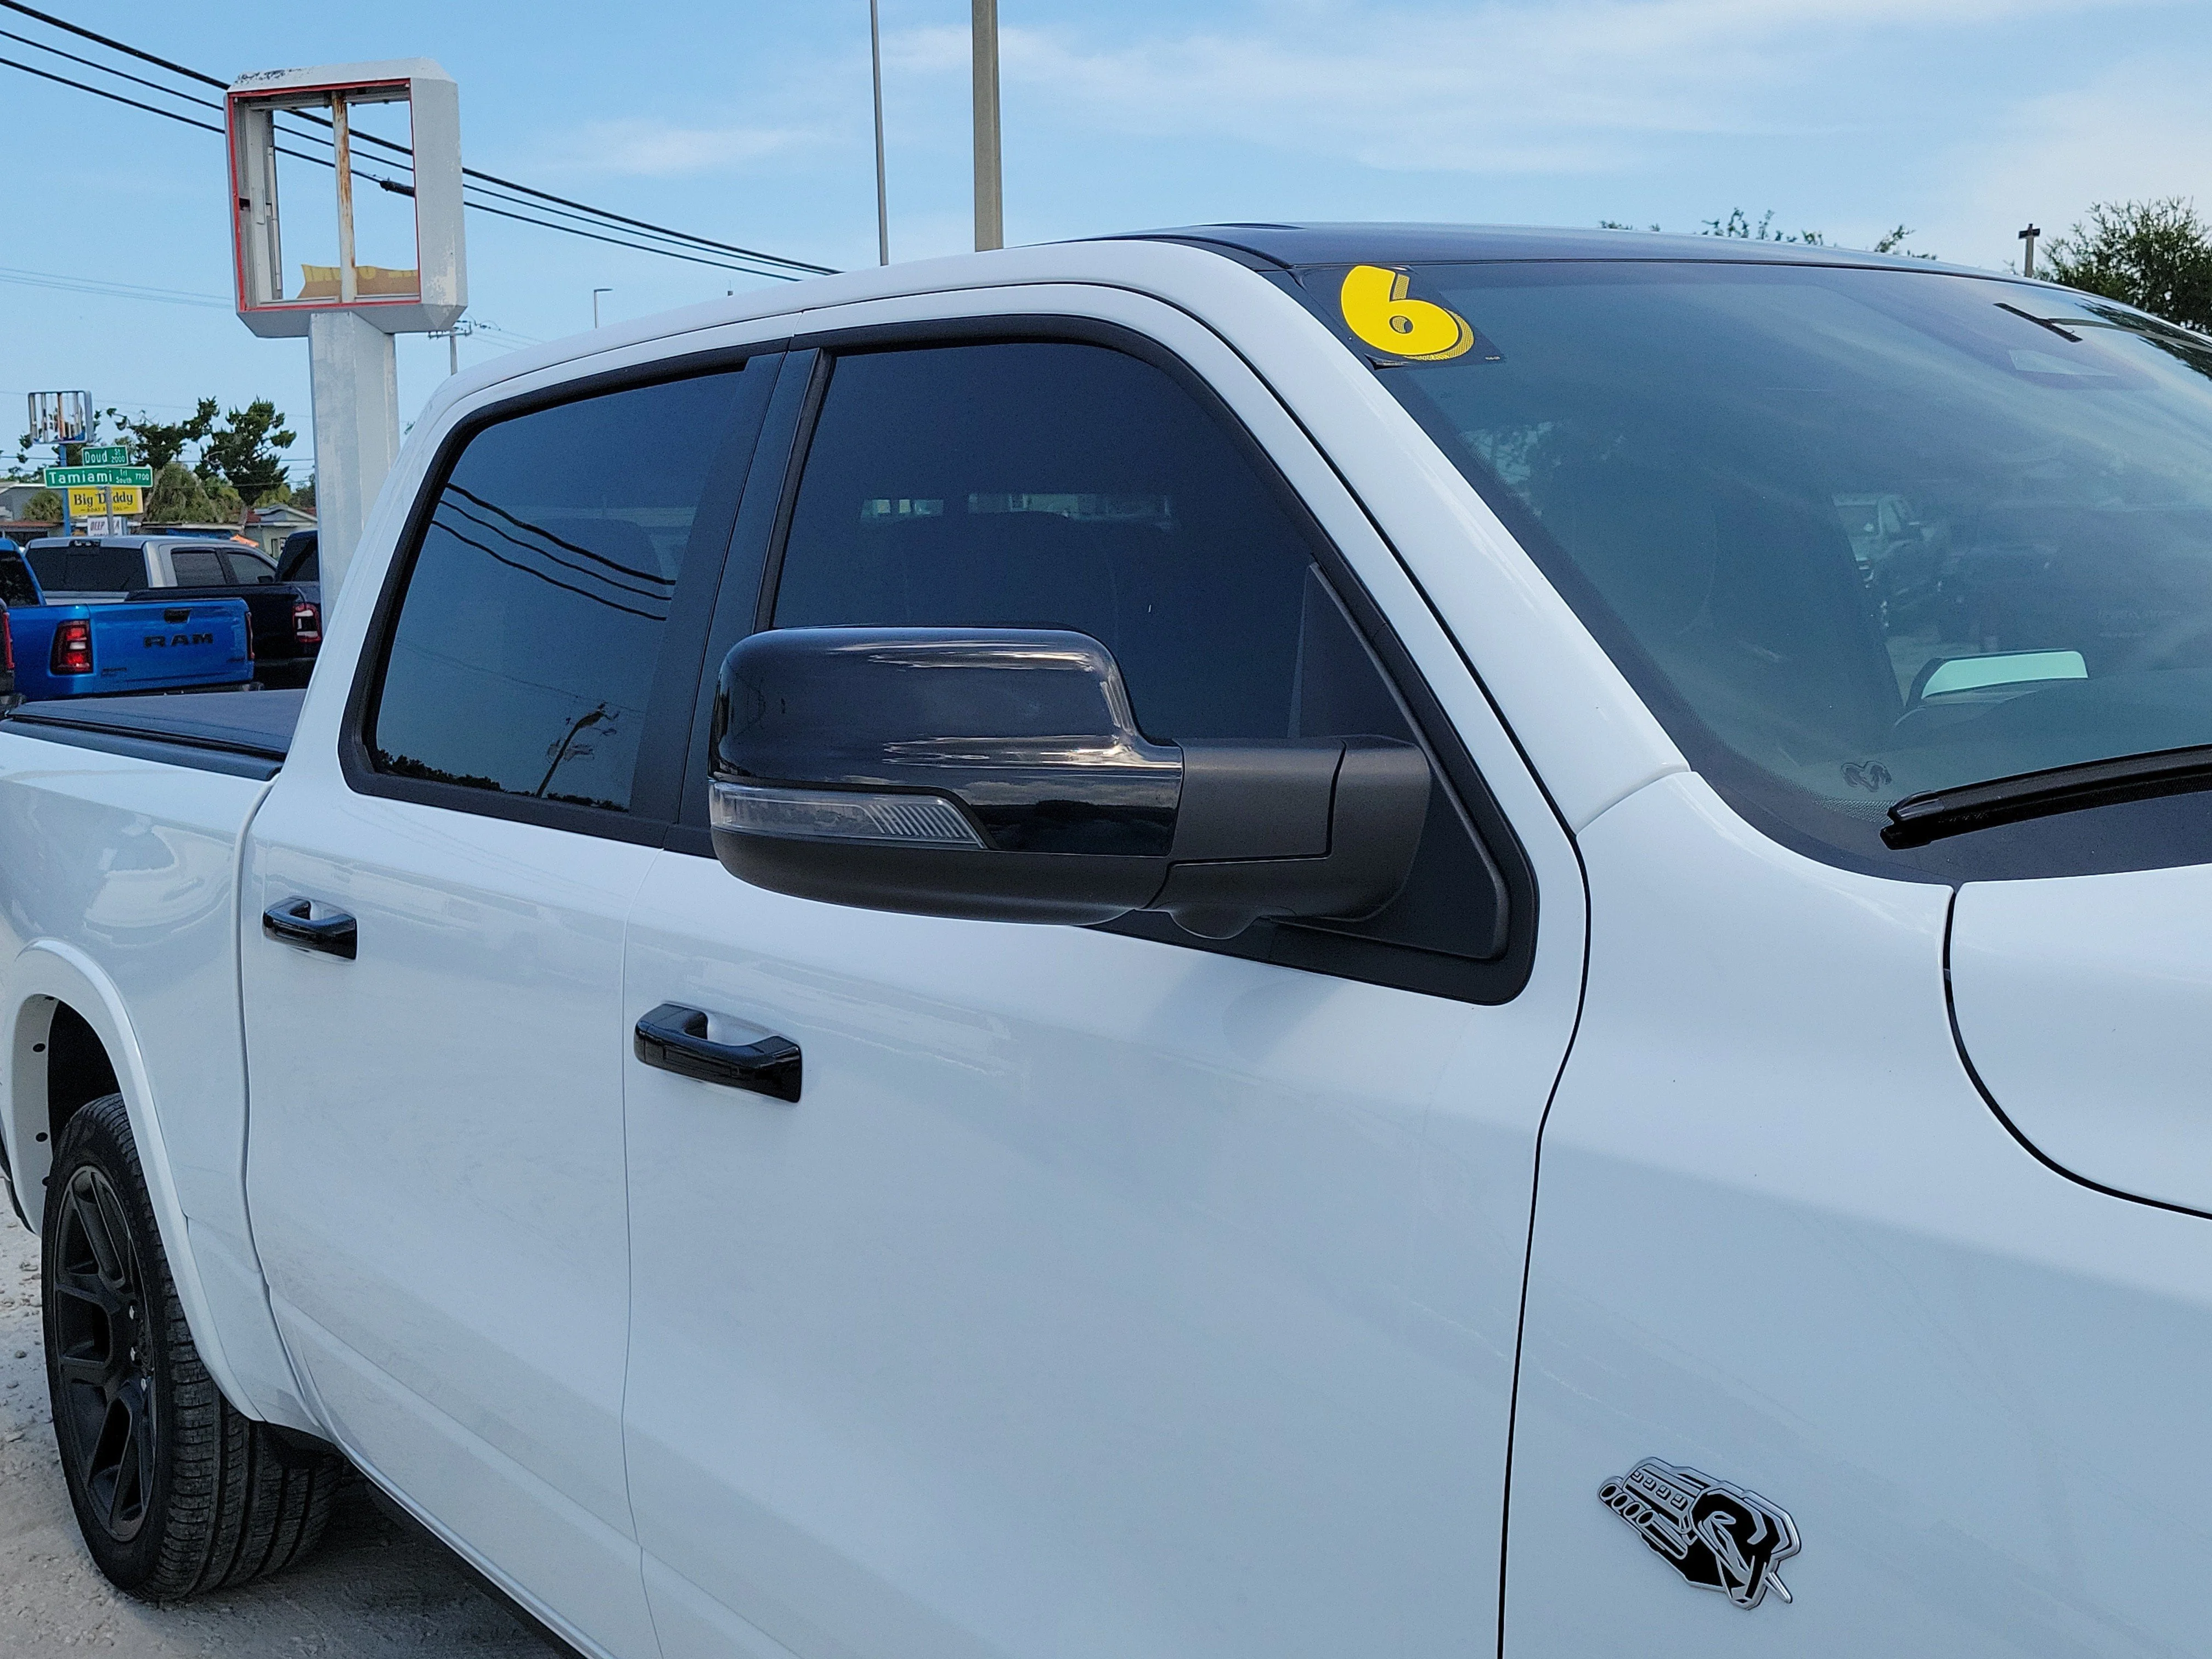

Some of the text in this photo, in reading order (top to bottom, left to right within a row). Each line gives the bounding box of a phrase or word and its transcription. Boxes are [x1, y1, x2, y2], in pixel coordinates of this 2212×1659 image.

[1341, 265, 1474, 360] 6
[84, 450, 108, 463] Doud
[49, 470, 112, 484] Tamiami
[135, 473, 149, 481] 7700
[74, 492, 133, 507] Big Dddy
[143, 633, 213, 647] RAM
